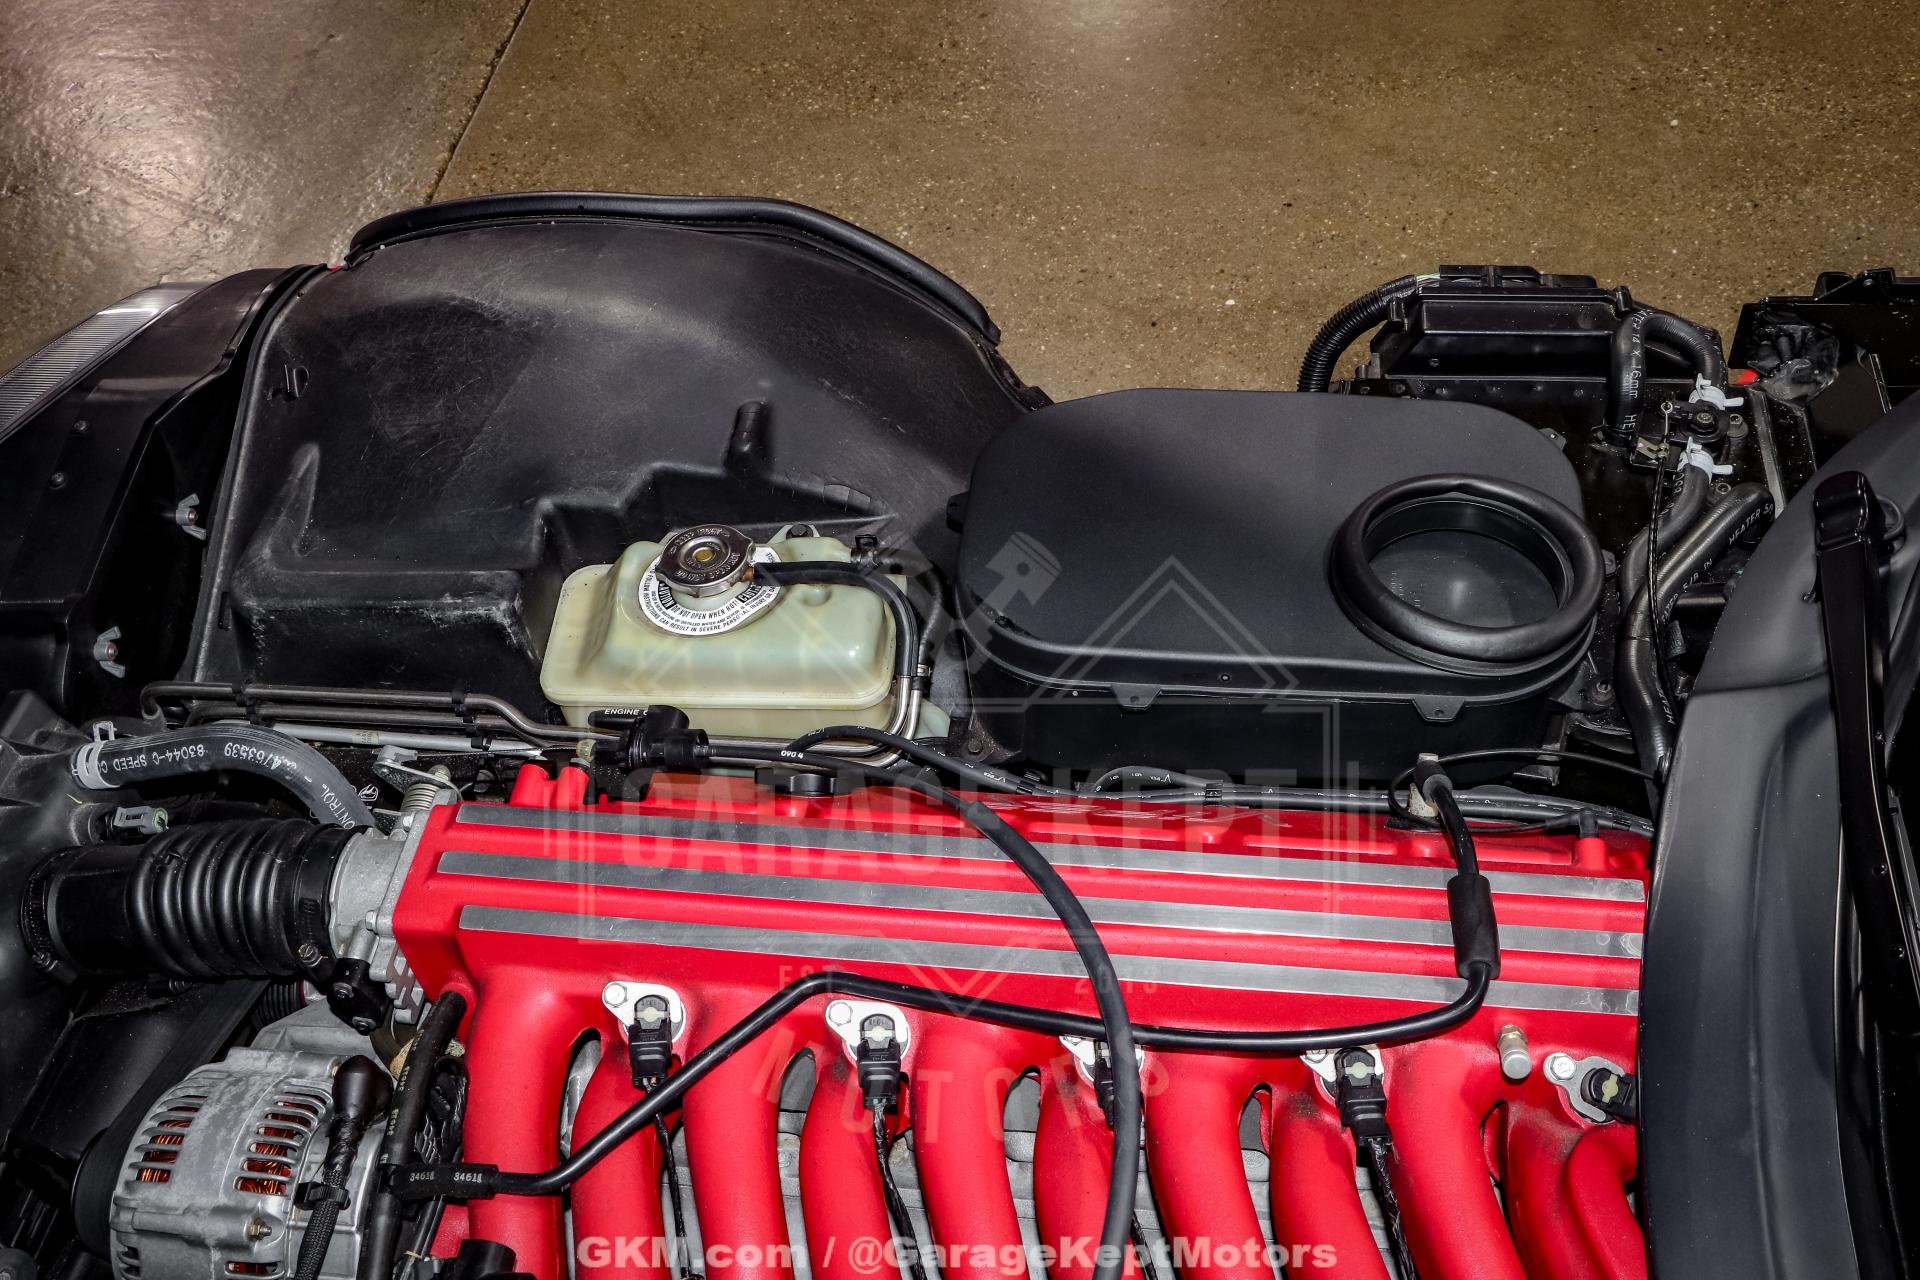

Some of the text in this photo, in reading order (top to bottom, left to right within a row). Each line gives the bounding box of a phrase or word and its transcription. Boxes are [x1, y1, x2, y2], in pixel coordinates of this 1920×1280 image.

[679, 607, 691, 618] NOT
[691, 611, 707, 620] OPEN
[708, 610, 725, 619] WHEN
[726, 600, 740, 612] HOT!
[659, 617, 670, 626] CAN
[669, 622, 689, 631] RESULT
[699, 624, 721, 633] SEVERE
[603, 708, 640, 716] ENGINE
[113, 754, 147, 771] SPEED
[321, 784, 356, 830] ONTROL
